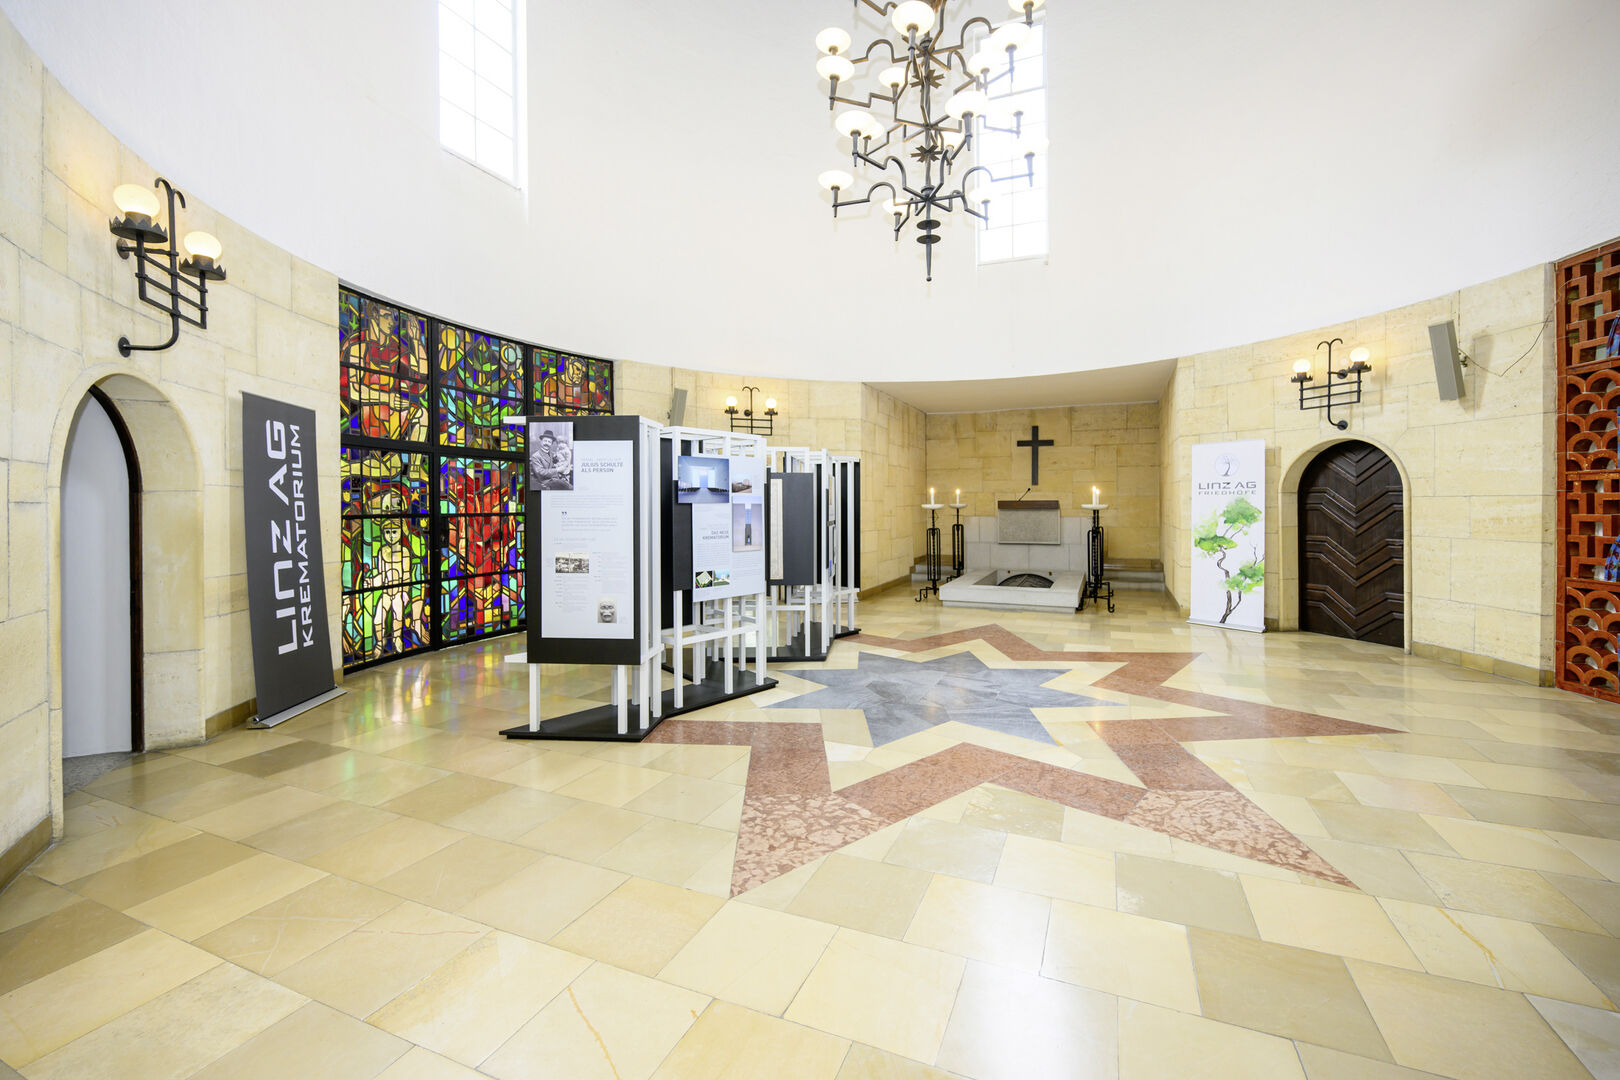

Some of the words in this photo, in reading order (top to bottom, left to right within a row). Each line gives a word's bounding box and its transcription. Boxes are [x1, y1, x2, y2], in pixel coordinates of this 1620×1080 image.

[265, 419, 289, 506] AG
[1198, 481, 1231, 490] LINZ
[1234, 481, 1257, 489] AG
[270, 519, 299, 656] LINZ
[289, 423, 315, 647] KREMATORIUM
